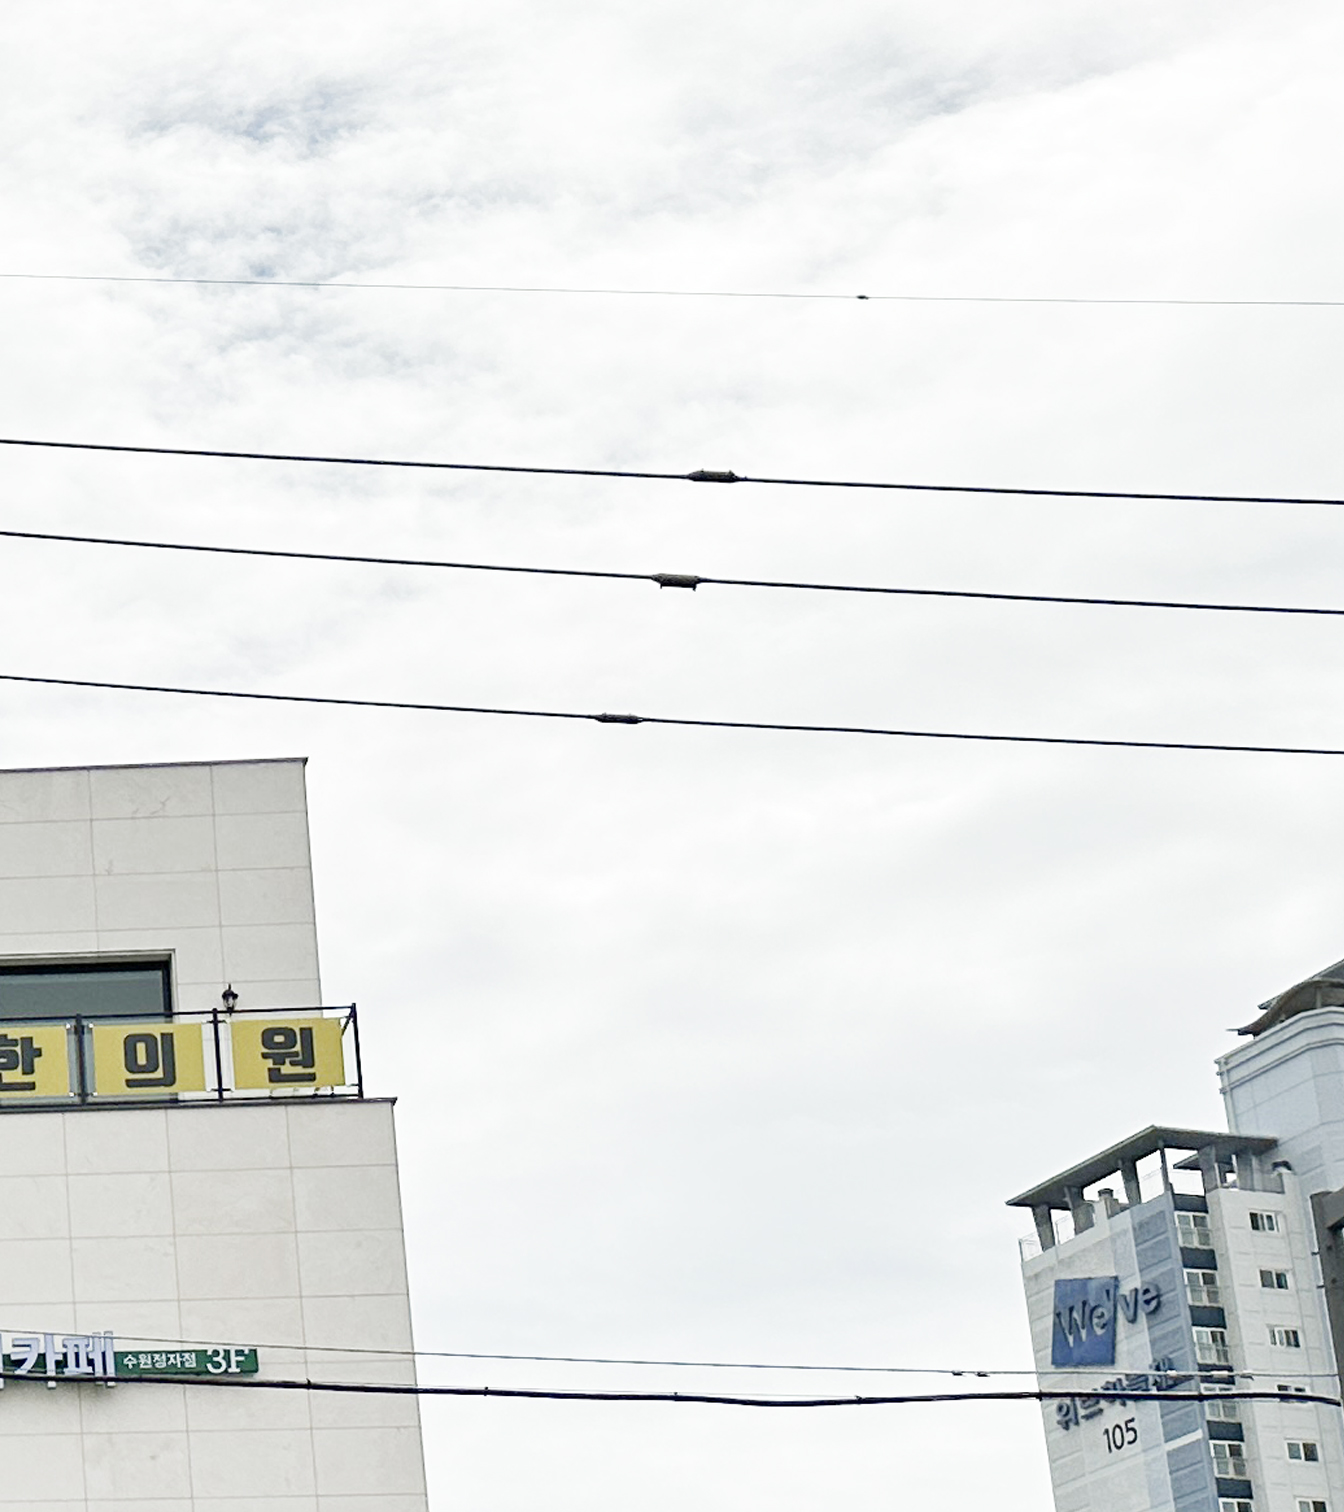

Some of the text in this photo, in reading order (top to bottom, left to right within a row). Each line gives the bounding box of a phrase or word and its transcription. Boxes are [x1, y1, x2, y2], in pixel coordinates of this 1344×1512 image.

[1056, 1281, 1162, 1348] We've
[123, 1351, 198, 1369] 수원정자점
[205, 1347, 250, 1374] 3F
[1103, 1416, 1138, 1454] 105
